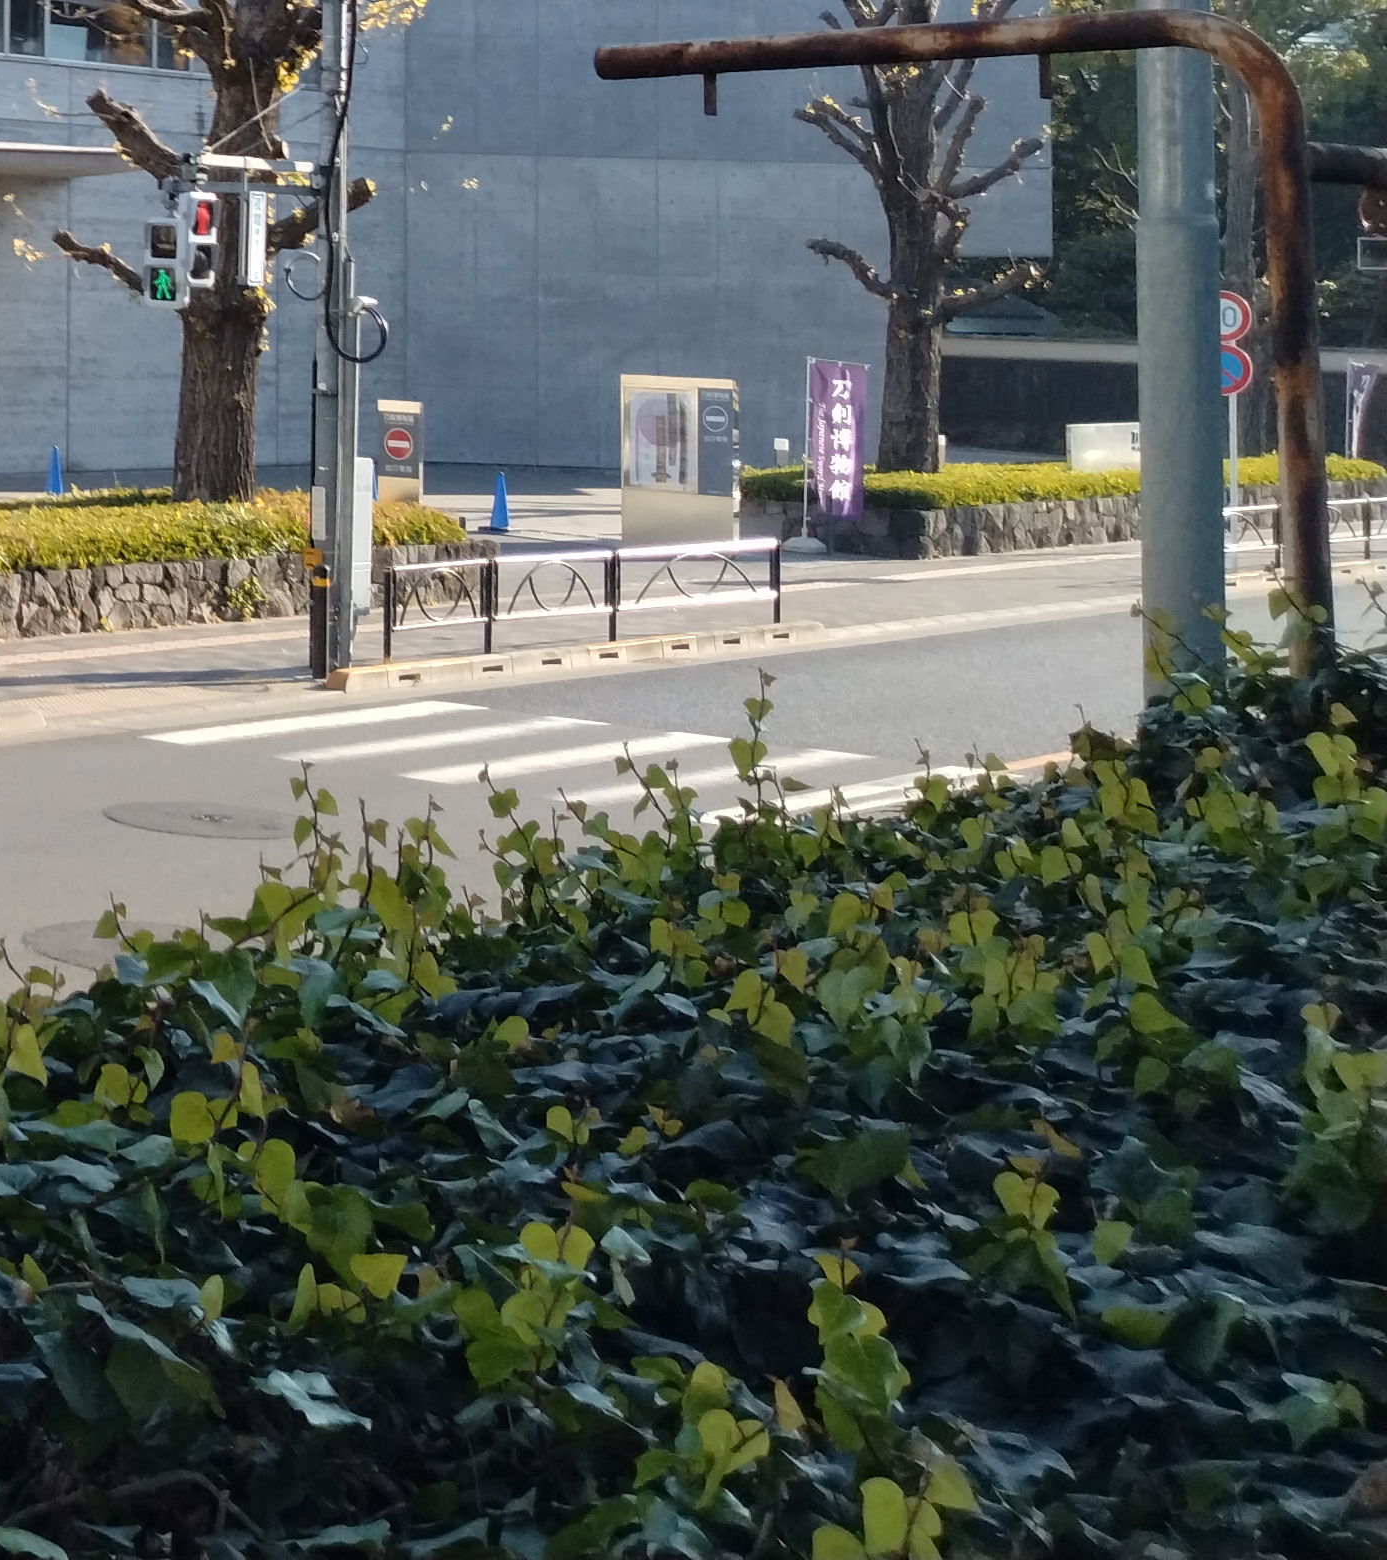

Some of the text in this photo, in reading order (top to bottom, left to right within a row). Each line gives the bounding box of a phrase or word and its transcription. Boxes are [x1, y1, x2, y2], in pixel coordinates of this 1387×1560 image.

[1222, 305, 1238, 328] 0
[828, 379, 854, 501] 刀剣博物館
